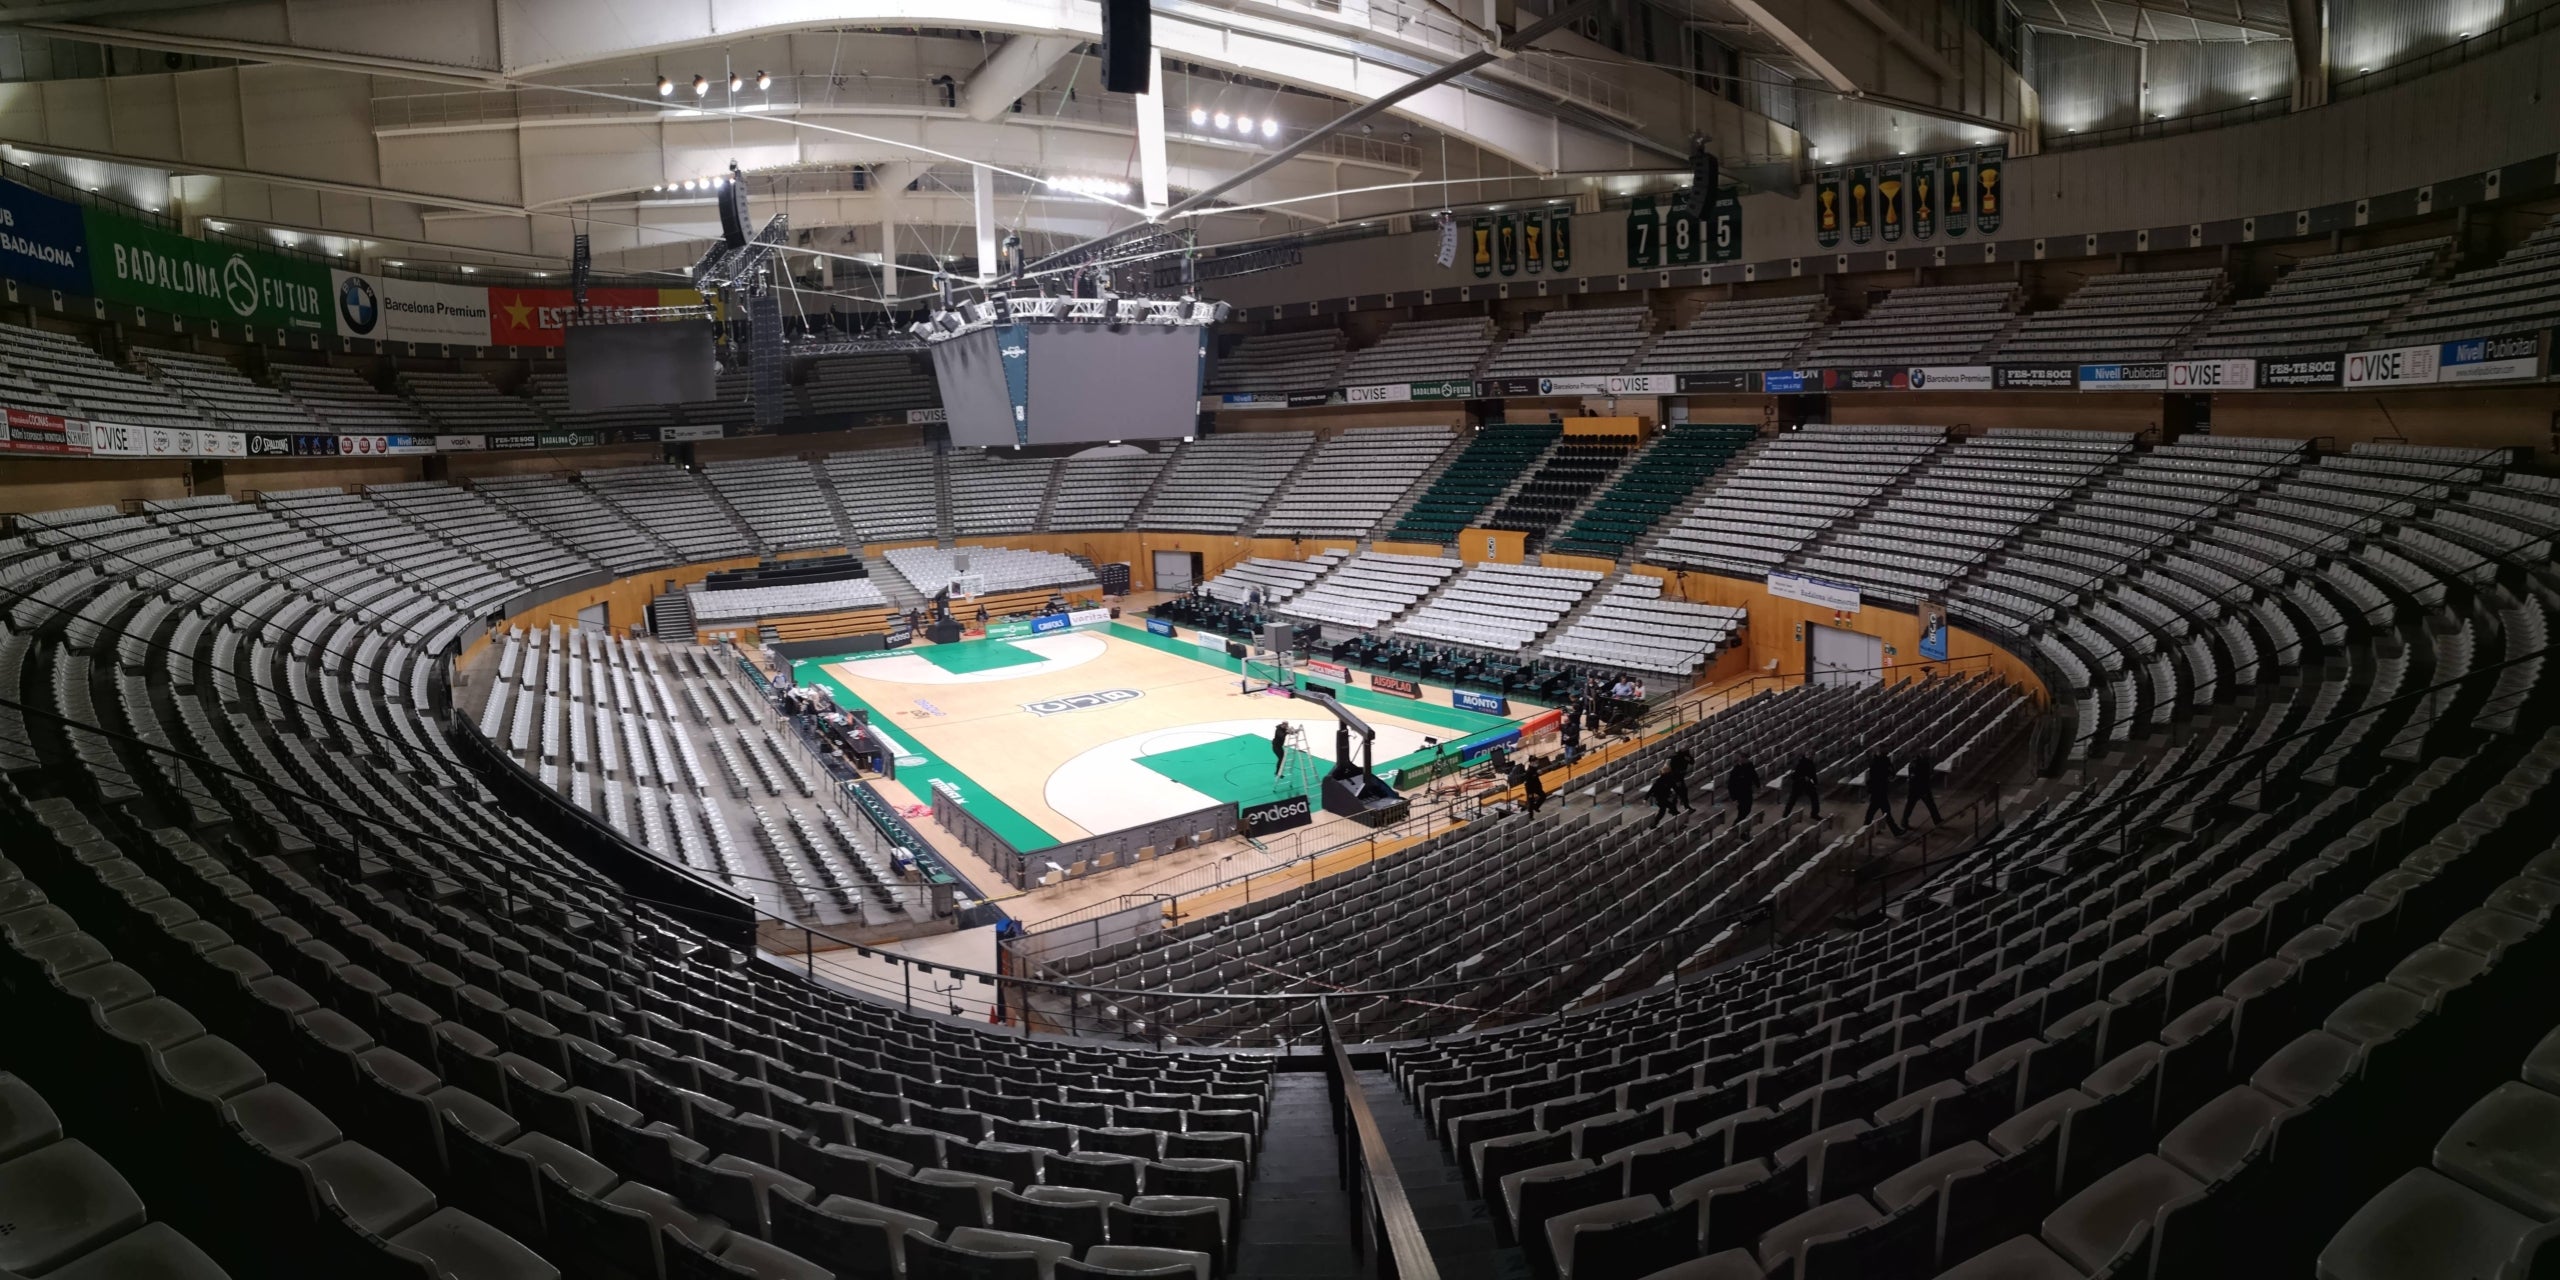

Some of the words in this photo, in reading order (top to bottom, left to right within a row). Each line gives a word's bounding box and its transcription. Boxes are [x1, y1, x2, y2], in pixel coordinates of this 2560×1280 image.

[1637, 223, 1649, 255] 7
[1676, 218, 1690, 250] 8
[1717, 214, 1731, 248] 5
[0, 232, 75, 268] BADALONA
[113, 243, 222, 299] BADALONA
[263, 277, 320, 315] FUTUR
[384, 297, 435, 315] Barcelona
[437, 302, 487, 319] Premium
[2456, 341, 2485, 362] Nivell
[2486, 334, 2538, 359] Publicitari
[2007, 370, 2045, 379] FES-TE
[2046, 369, 2072, 378] SOCI
[2095, 367, 2120, 379] Nivell
[2122, 366, 2166, 379] Publicitari
[2269, 362, 2308, 375] FES-TE
[2308, 361, 2336, 373] SOCI
[1553, 383, 1580, 391] Barcelona
[1926, 375, 1959, 383] Barcelona
[1960, 374, 1991, 383] Premium
[1412, 386, 1441, 396] BADALONA
[1452, 385, 1471, 394] FUTUR
[263, 436, 289, 453] SPALDING
[541, 436, 567, 445] BADALONA
[577, 434, 593, 444] FUTUR
[886, 632, 911, 644] endesa
[1248, 801, 1308, 826] endesa
